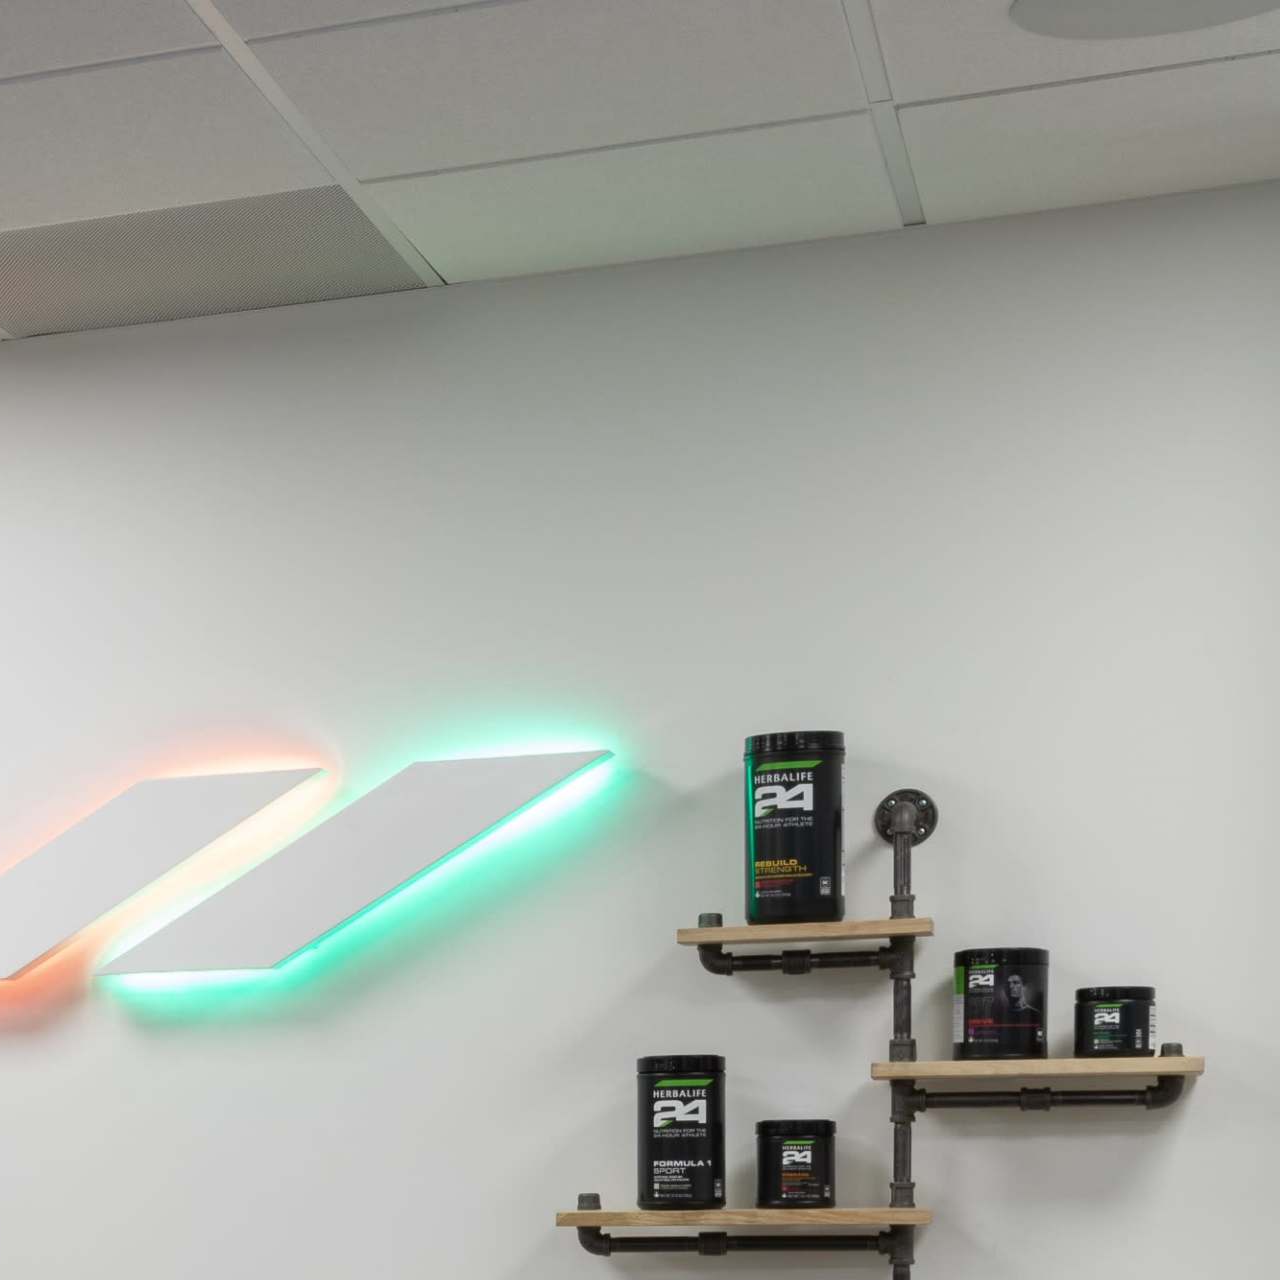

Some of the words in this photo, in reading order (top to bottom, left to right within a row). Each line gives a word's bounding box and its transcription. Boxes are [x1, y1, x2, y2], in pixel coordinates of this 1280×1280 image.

[754, 771, 814, 785] HERBALIFE
[755, 783, 814, 818] 24
[969, 974, 995, 989] 24
[1094, 1012, 1120, 1025] 24
[653, 1088, 708, 1098] HERBALIFE
[653, 1099, 707, 1128] 24
[653, 1160, 705, 1168] FORMULA
[706, 1160, 713, 1168] 1
[782, 1150, 812, 1165] 24
[653, 1167, 686, 1175] SPORT
